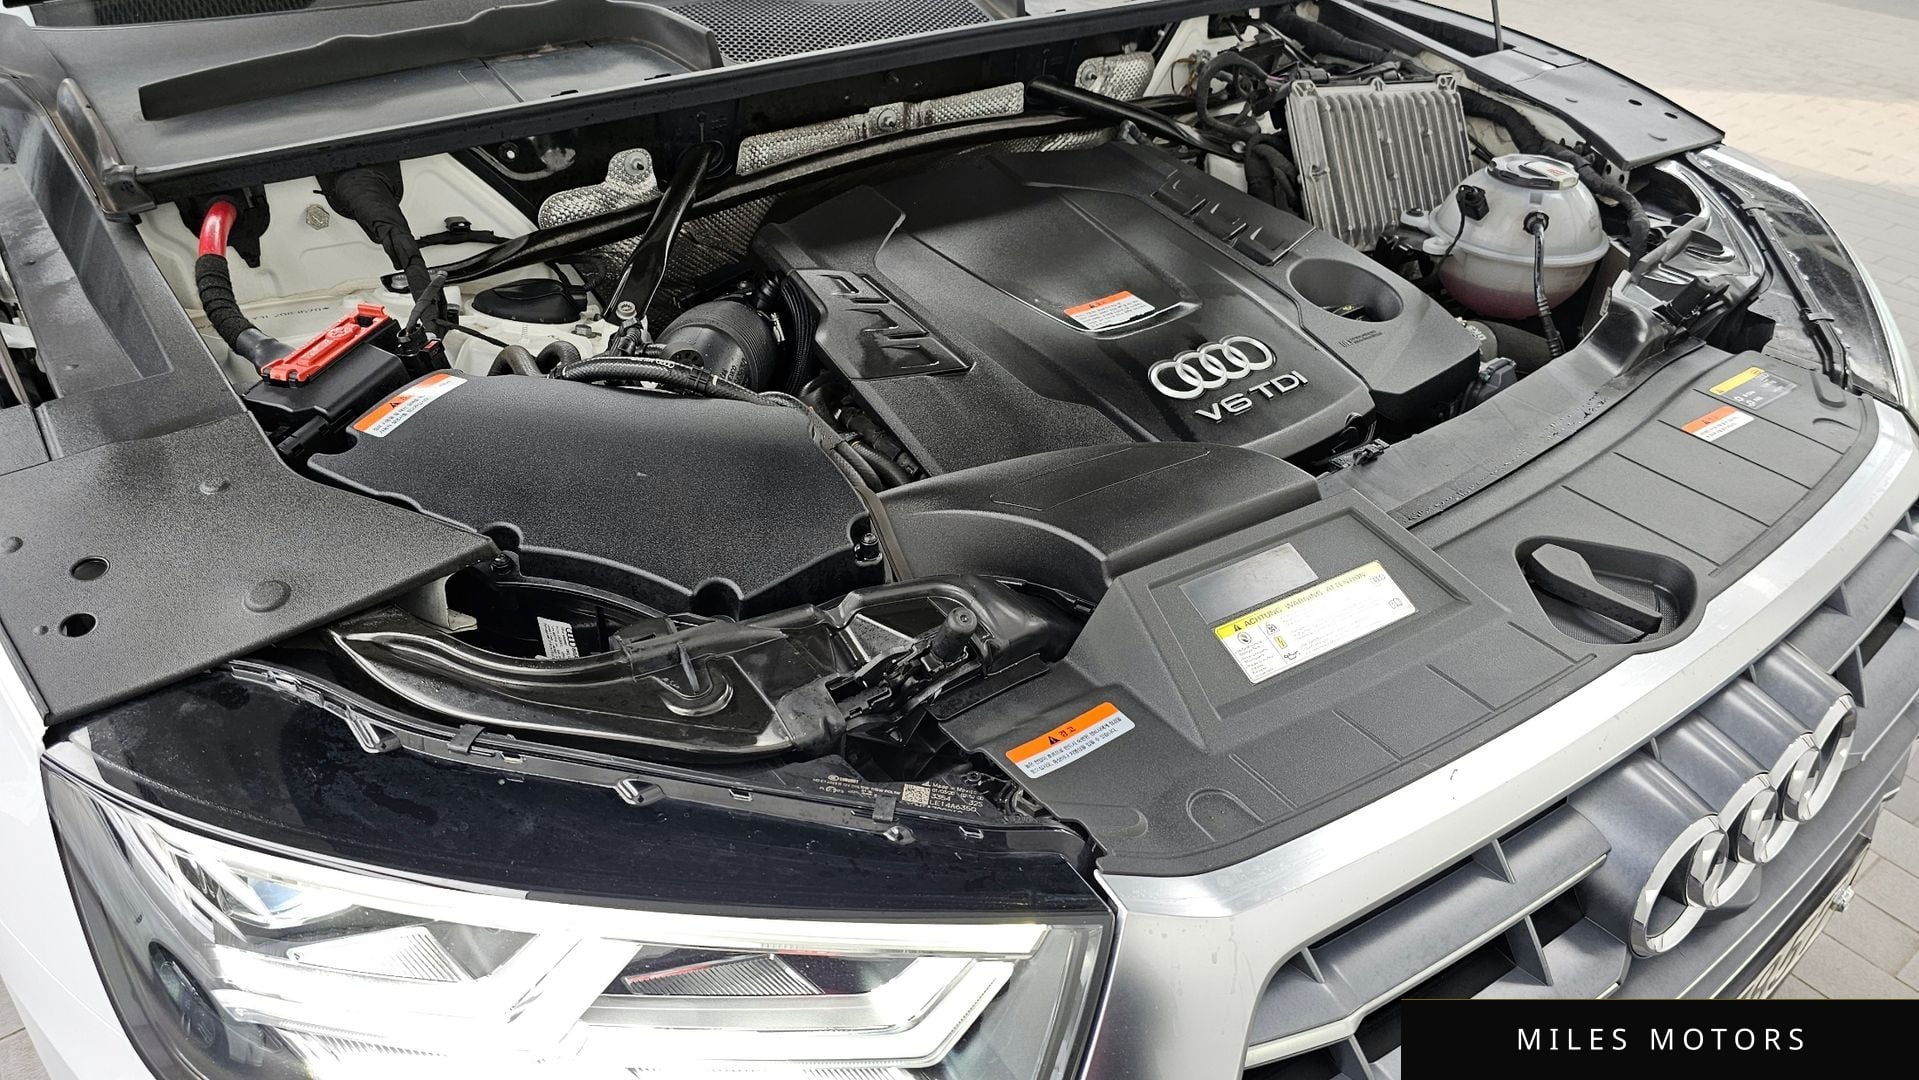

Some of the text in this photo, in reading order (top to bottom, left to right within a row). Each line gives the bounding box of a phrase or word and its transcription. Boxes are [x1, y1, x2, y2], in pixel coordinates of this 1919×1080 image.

[1194, 369, 1309, 424] V6 TDI
[1243, 571, 1367, 627] ACHTUNG WARNING ATTENTION
